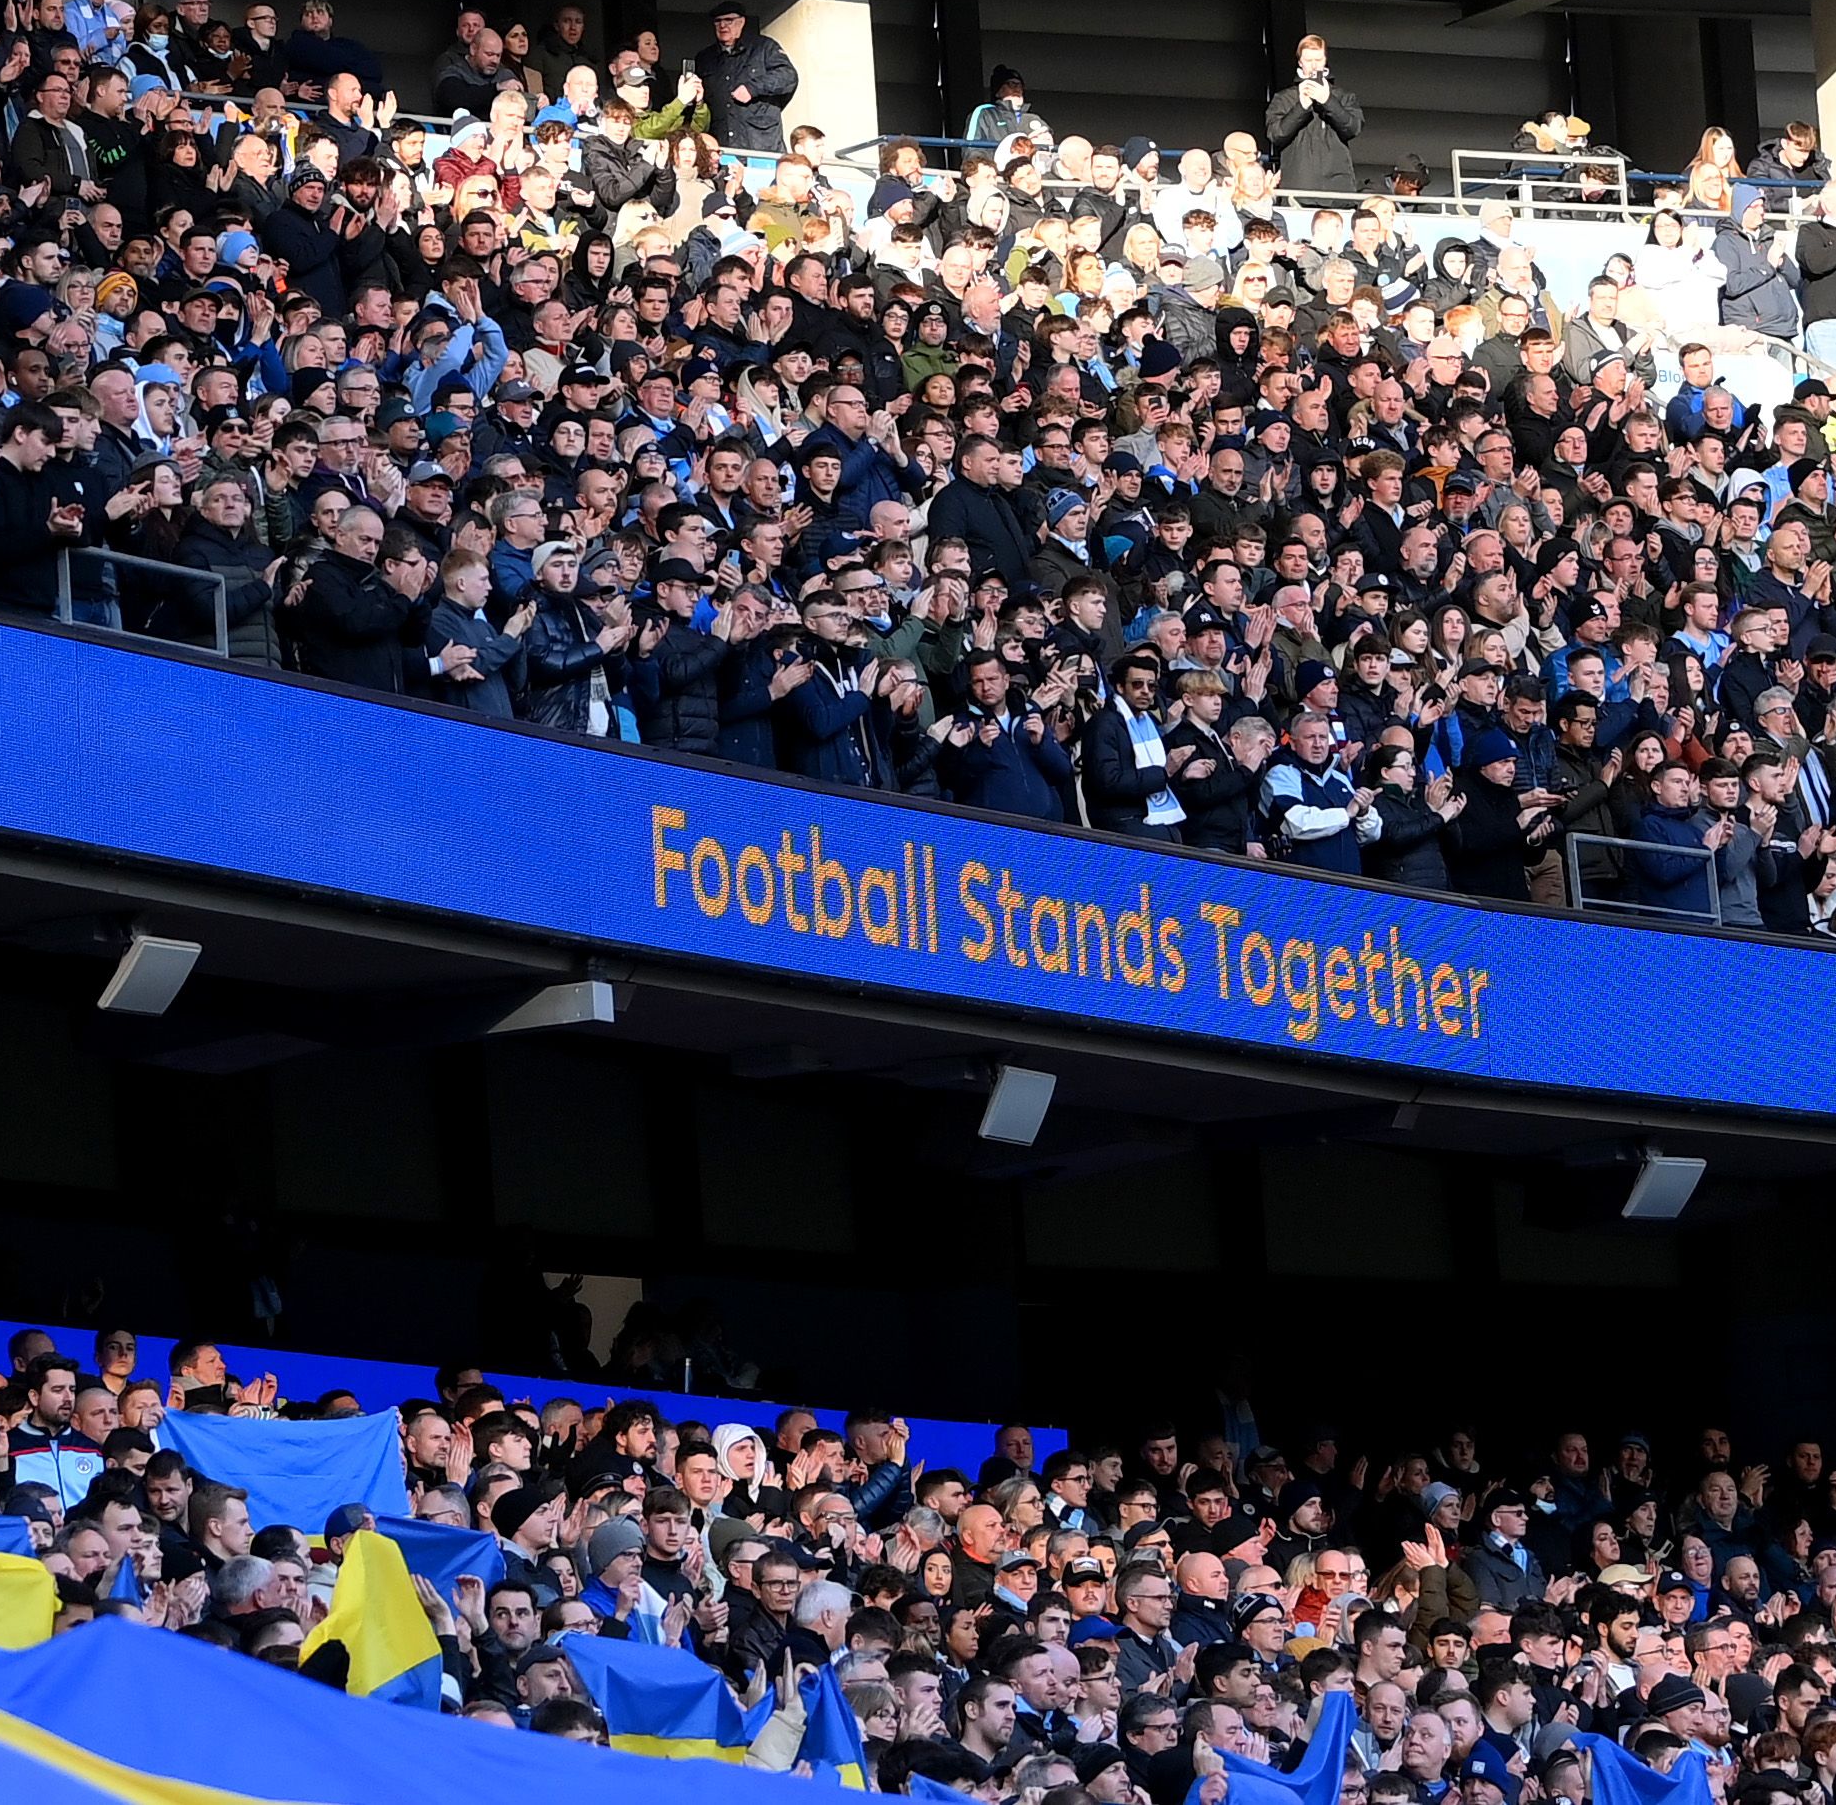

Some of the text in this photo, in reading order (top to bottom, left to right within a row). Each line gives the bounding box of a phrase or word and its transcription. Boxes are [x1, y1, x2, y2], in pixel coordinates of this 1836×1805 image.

[1658, 369, 1685, 383] Blo
[653, 805, 1489, 1041] Football Stands Together
